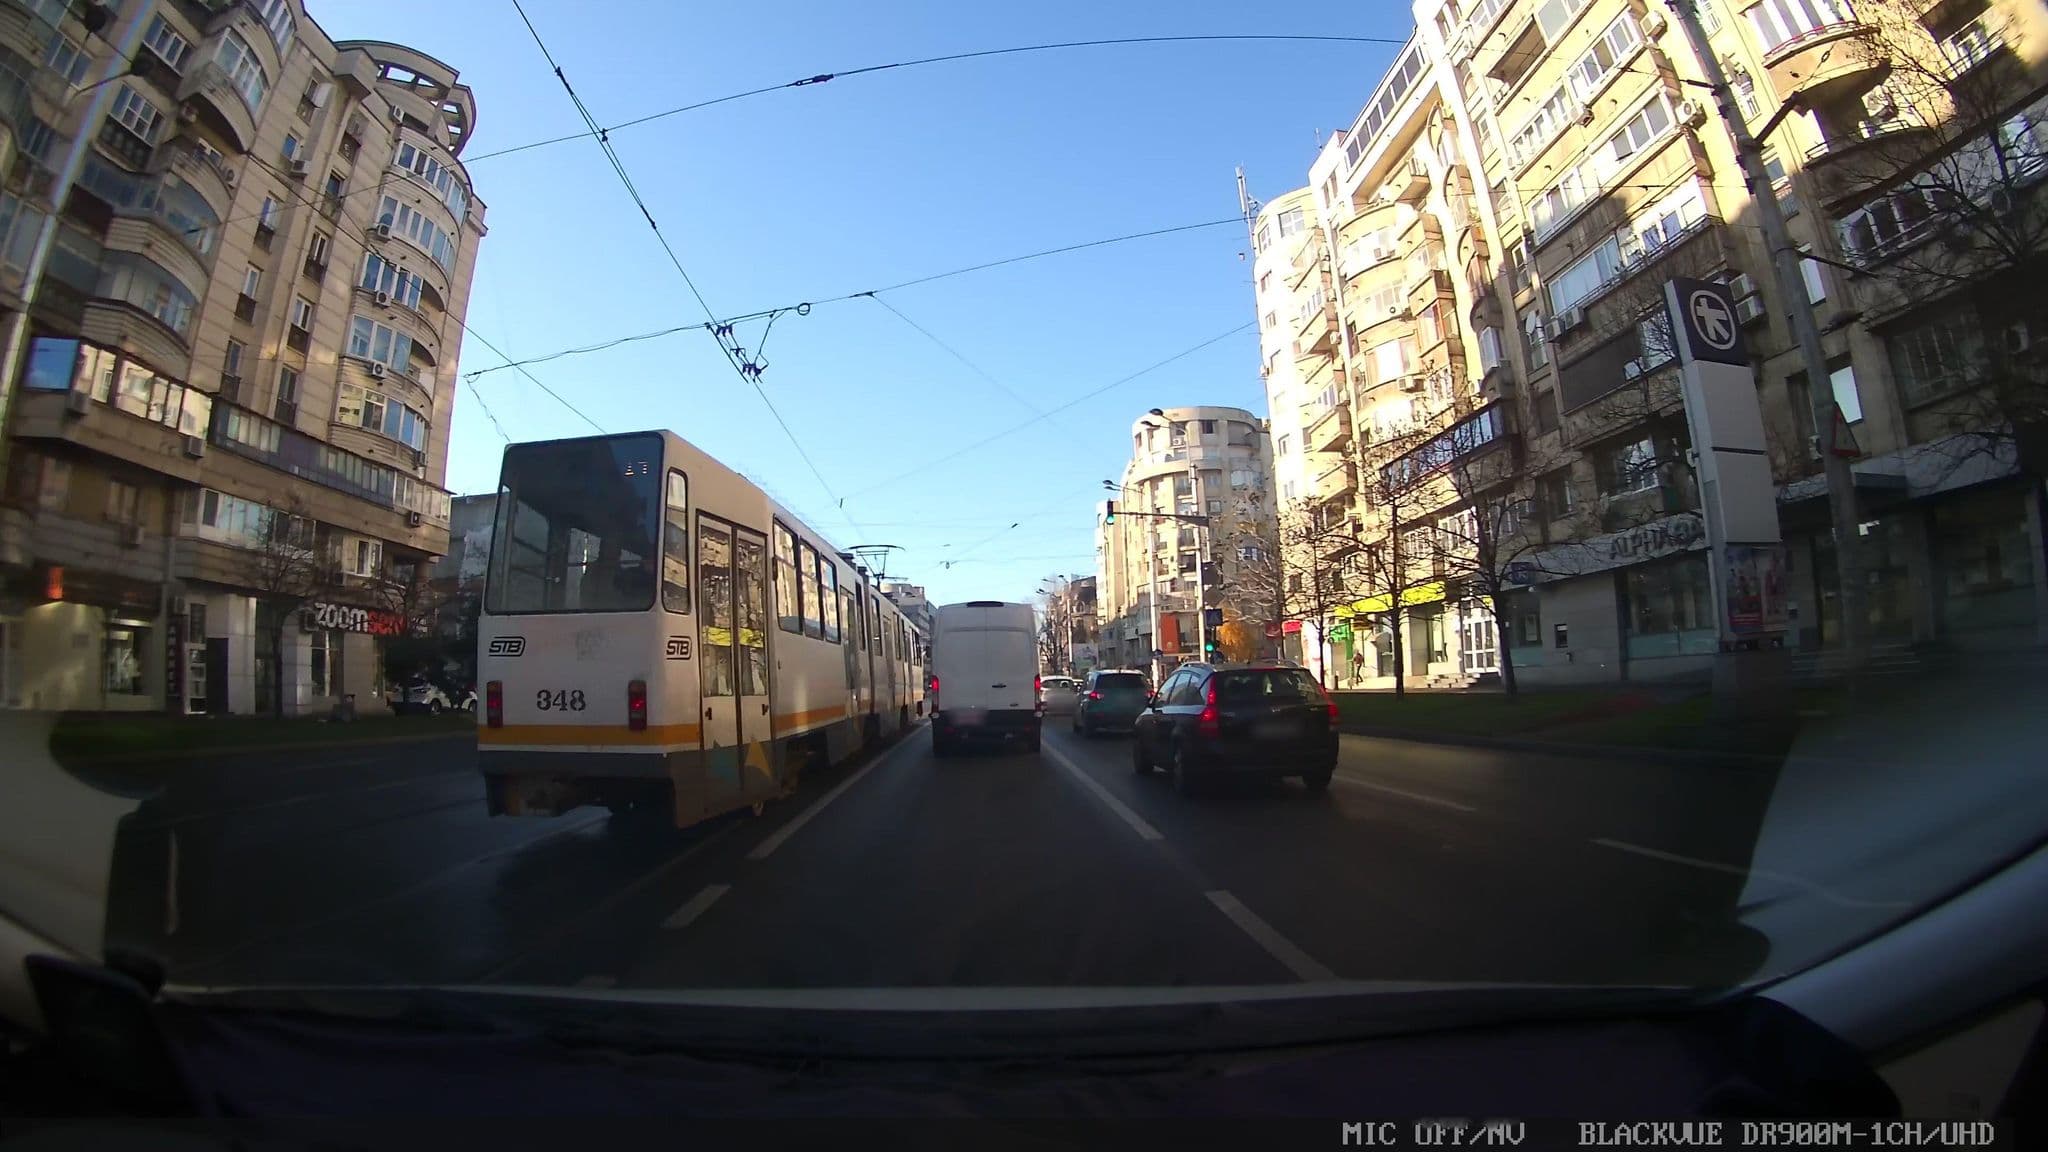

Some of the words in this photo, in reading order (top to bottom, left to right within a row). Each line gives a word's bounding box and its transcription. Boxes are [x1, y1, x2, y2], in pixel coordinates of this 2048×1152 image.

[488, 639, 522, 654] STB
[665, 639, 690, 656] STB
[537, 690, 586, 711] 348
